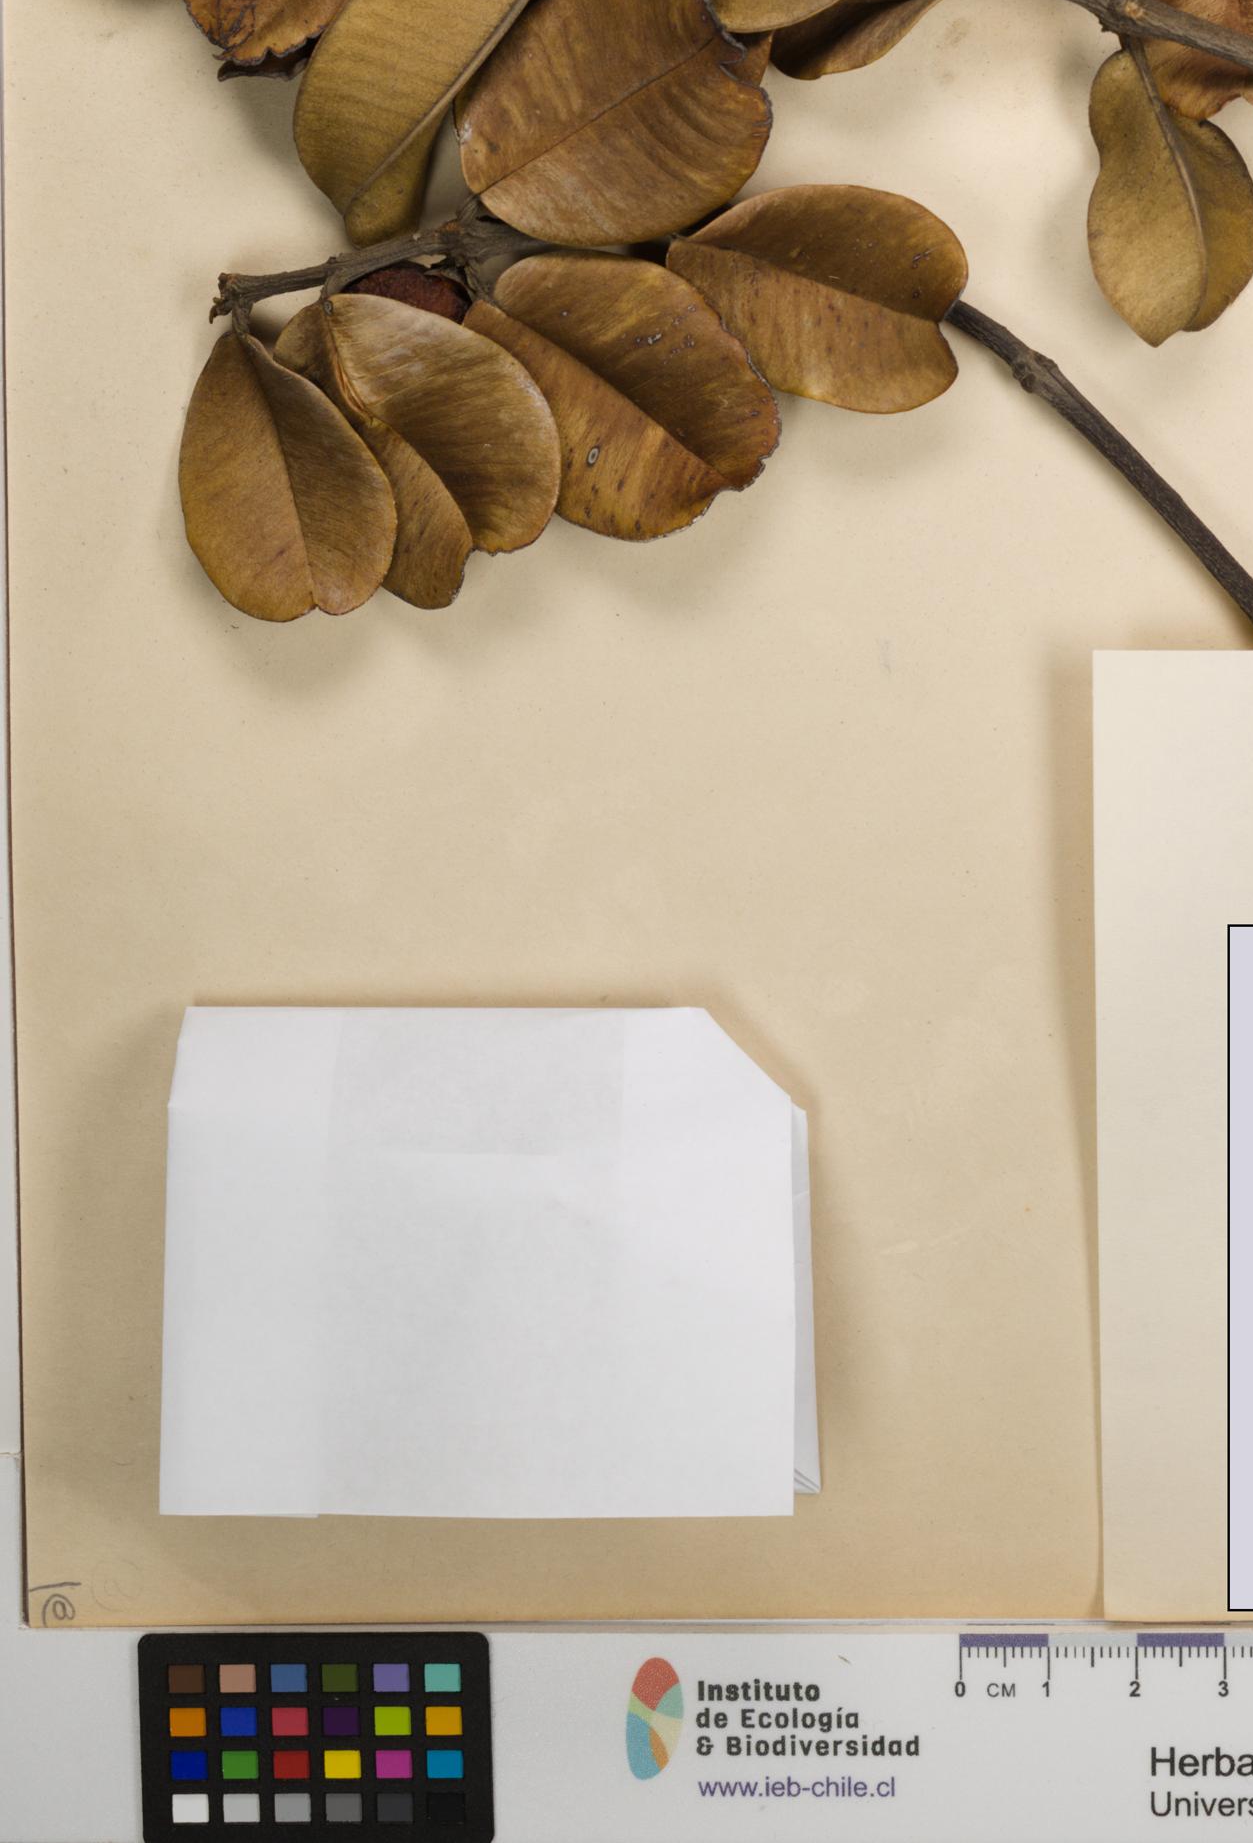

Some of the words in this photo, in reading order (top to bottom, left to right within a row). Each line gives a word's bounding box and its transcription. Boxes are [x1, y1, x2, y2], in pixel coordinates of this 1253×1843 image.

[697, 1678, 820, 1702] Instituto
[955, 1680, 966, 1698] 0
[987, 1682, 1016, 1698] CM
[1042, 1680, 1051, 1698] 1
[1129, 1680, 1141, 1698] 2
[1218, 1680, 1230, 1697] 3
[695, 1707, 728, 1730] de
[741, 1707, 861, 1736] Ecología
[696, 1735, 714, 1757] &
[726, 1732, 920, 1758] Biodiversidad
[697, 1775, 896, 1798] www.ieb-chile.cl
